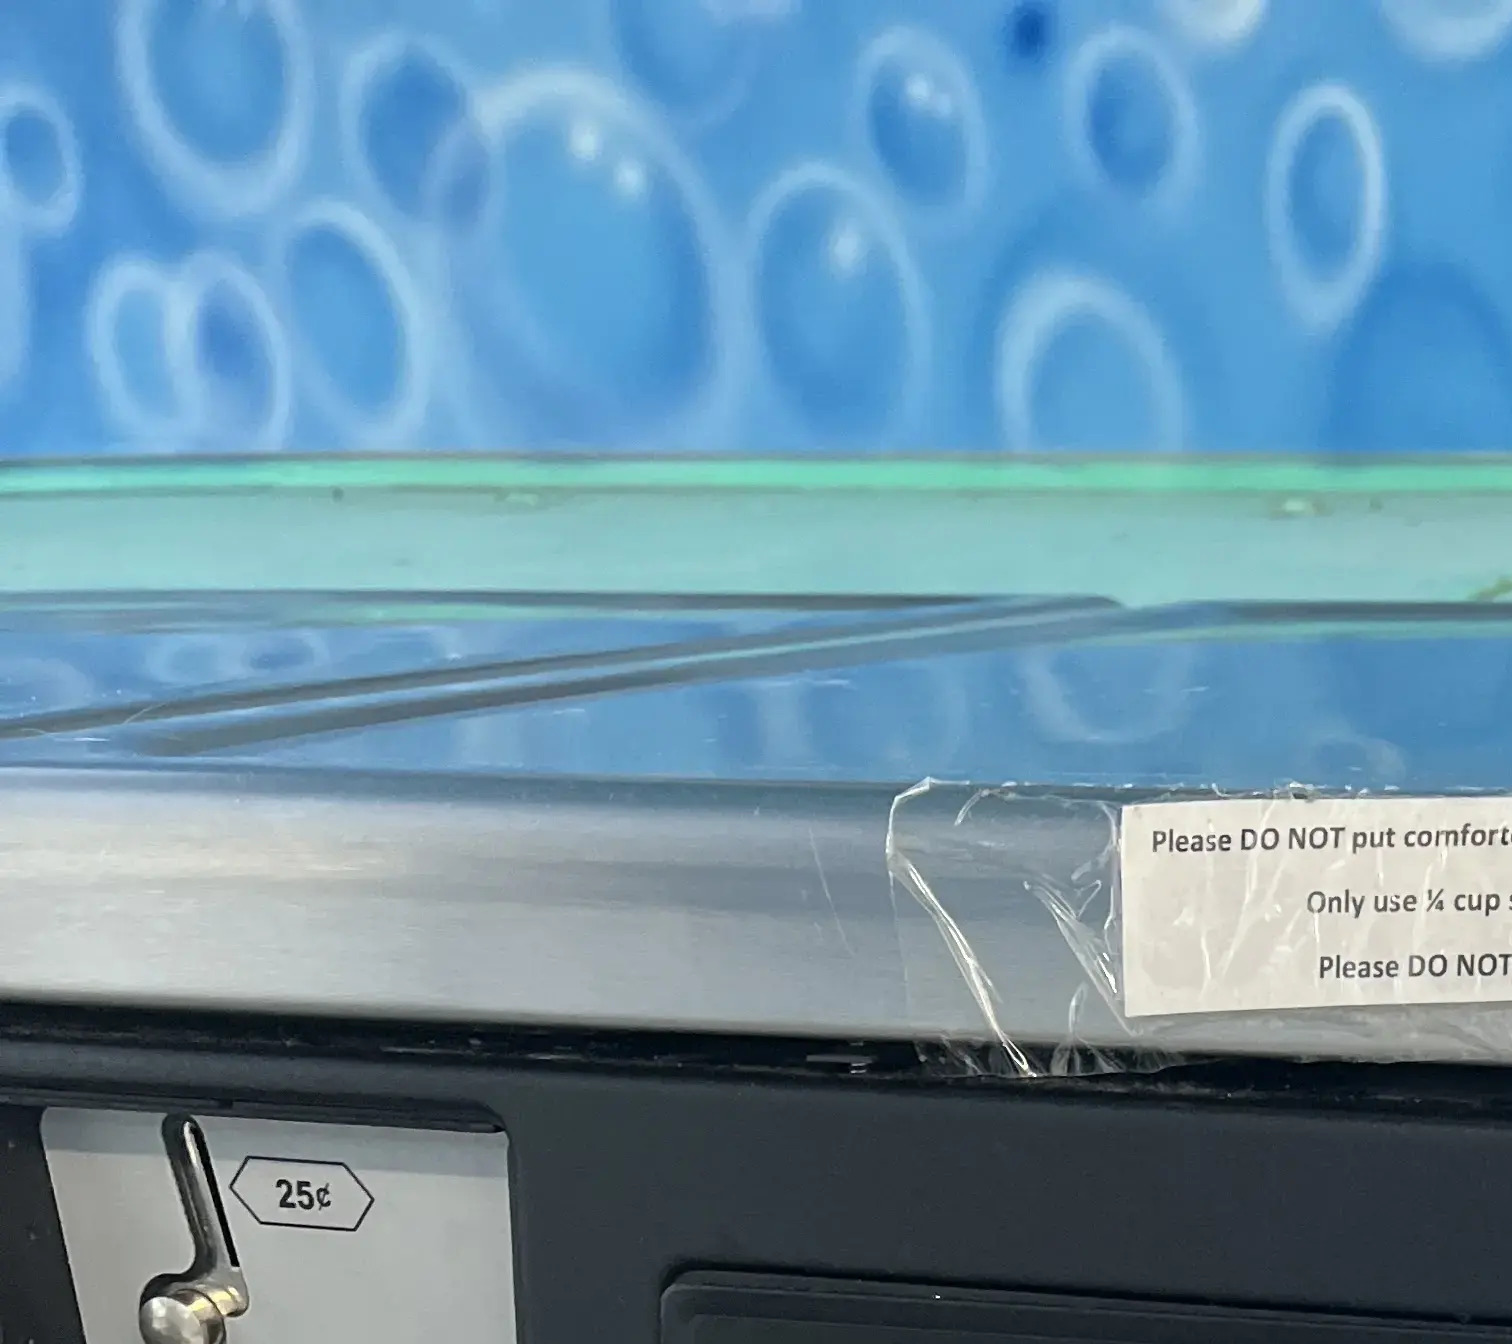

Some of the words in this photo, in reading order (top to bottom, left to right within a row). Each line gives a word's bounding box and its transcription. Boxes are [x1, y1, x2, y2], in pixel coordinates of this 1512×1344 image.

[1152, 830, 1232, 853] Please
[1241, 828, 1279, 851] DO
[1289, 827, 1345, 849] NOT
[1352, 828, 1395, 854] put
[1307, 890, 1365, 919] Only
[1374, 894, 1417, 913] use
[1454, 893, 1500, 916] cup
[1320, 955, 1399, 979] Please
[1408, 955, 1447, 977] DO
[1457, 954, 1512, 977] NOT
[275, 1179, 332, 1211] 25¢
